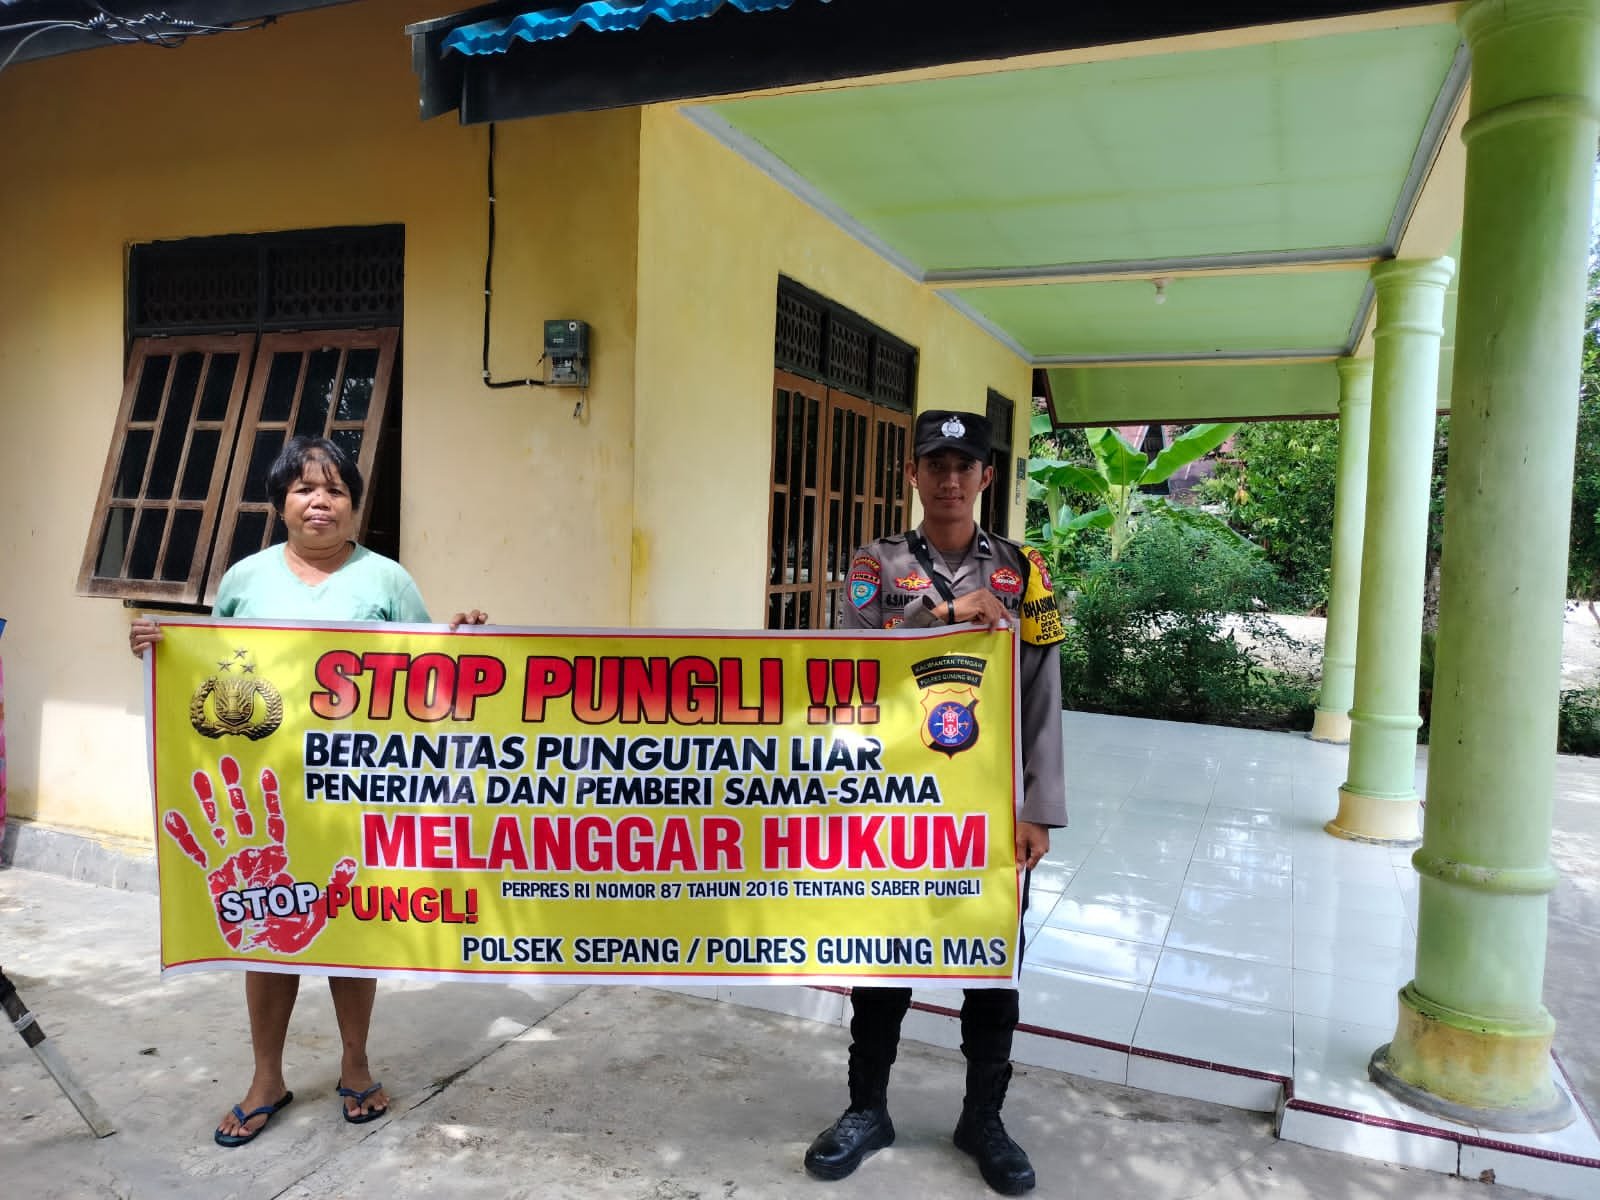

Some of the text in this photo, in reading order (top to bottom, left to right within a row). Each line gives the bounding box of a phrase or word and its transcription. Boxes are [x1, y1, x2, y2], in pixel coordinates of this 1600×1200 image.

[957, 658, 983, 669] TENGAH
[310, 650, 881, 726] STOP PUNGLI !!!
[305, 733, 882, 772] BERANTAS PUNGUTAN LIAR
[306, 773, 941, 805] PENERIMA DAN PEMBERI SAMA-SAMA
[363, 813, 986, 872] MELANGGAR HUKUM
[219, 882, 319, 923] STOP
[501, 879, 981, 899] PERPRES RI NOMOR 87 TAHUN 2016 TENTANG SABER PUNGLI
[463, 937, 563, 963] POLSEK
[574, 937, 680, 963] SEPANG
[707, 938, 807, 964] POLRES
[816, 938, 933, 965] GUNUNG
[943, 938, 1007, 966] MAS
